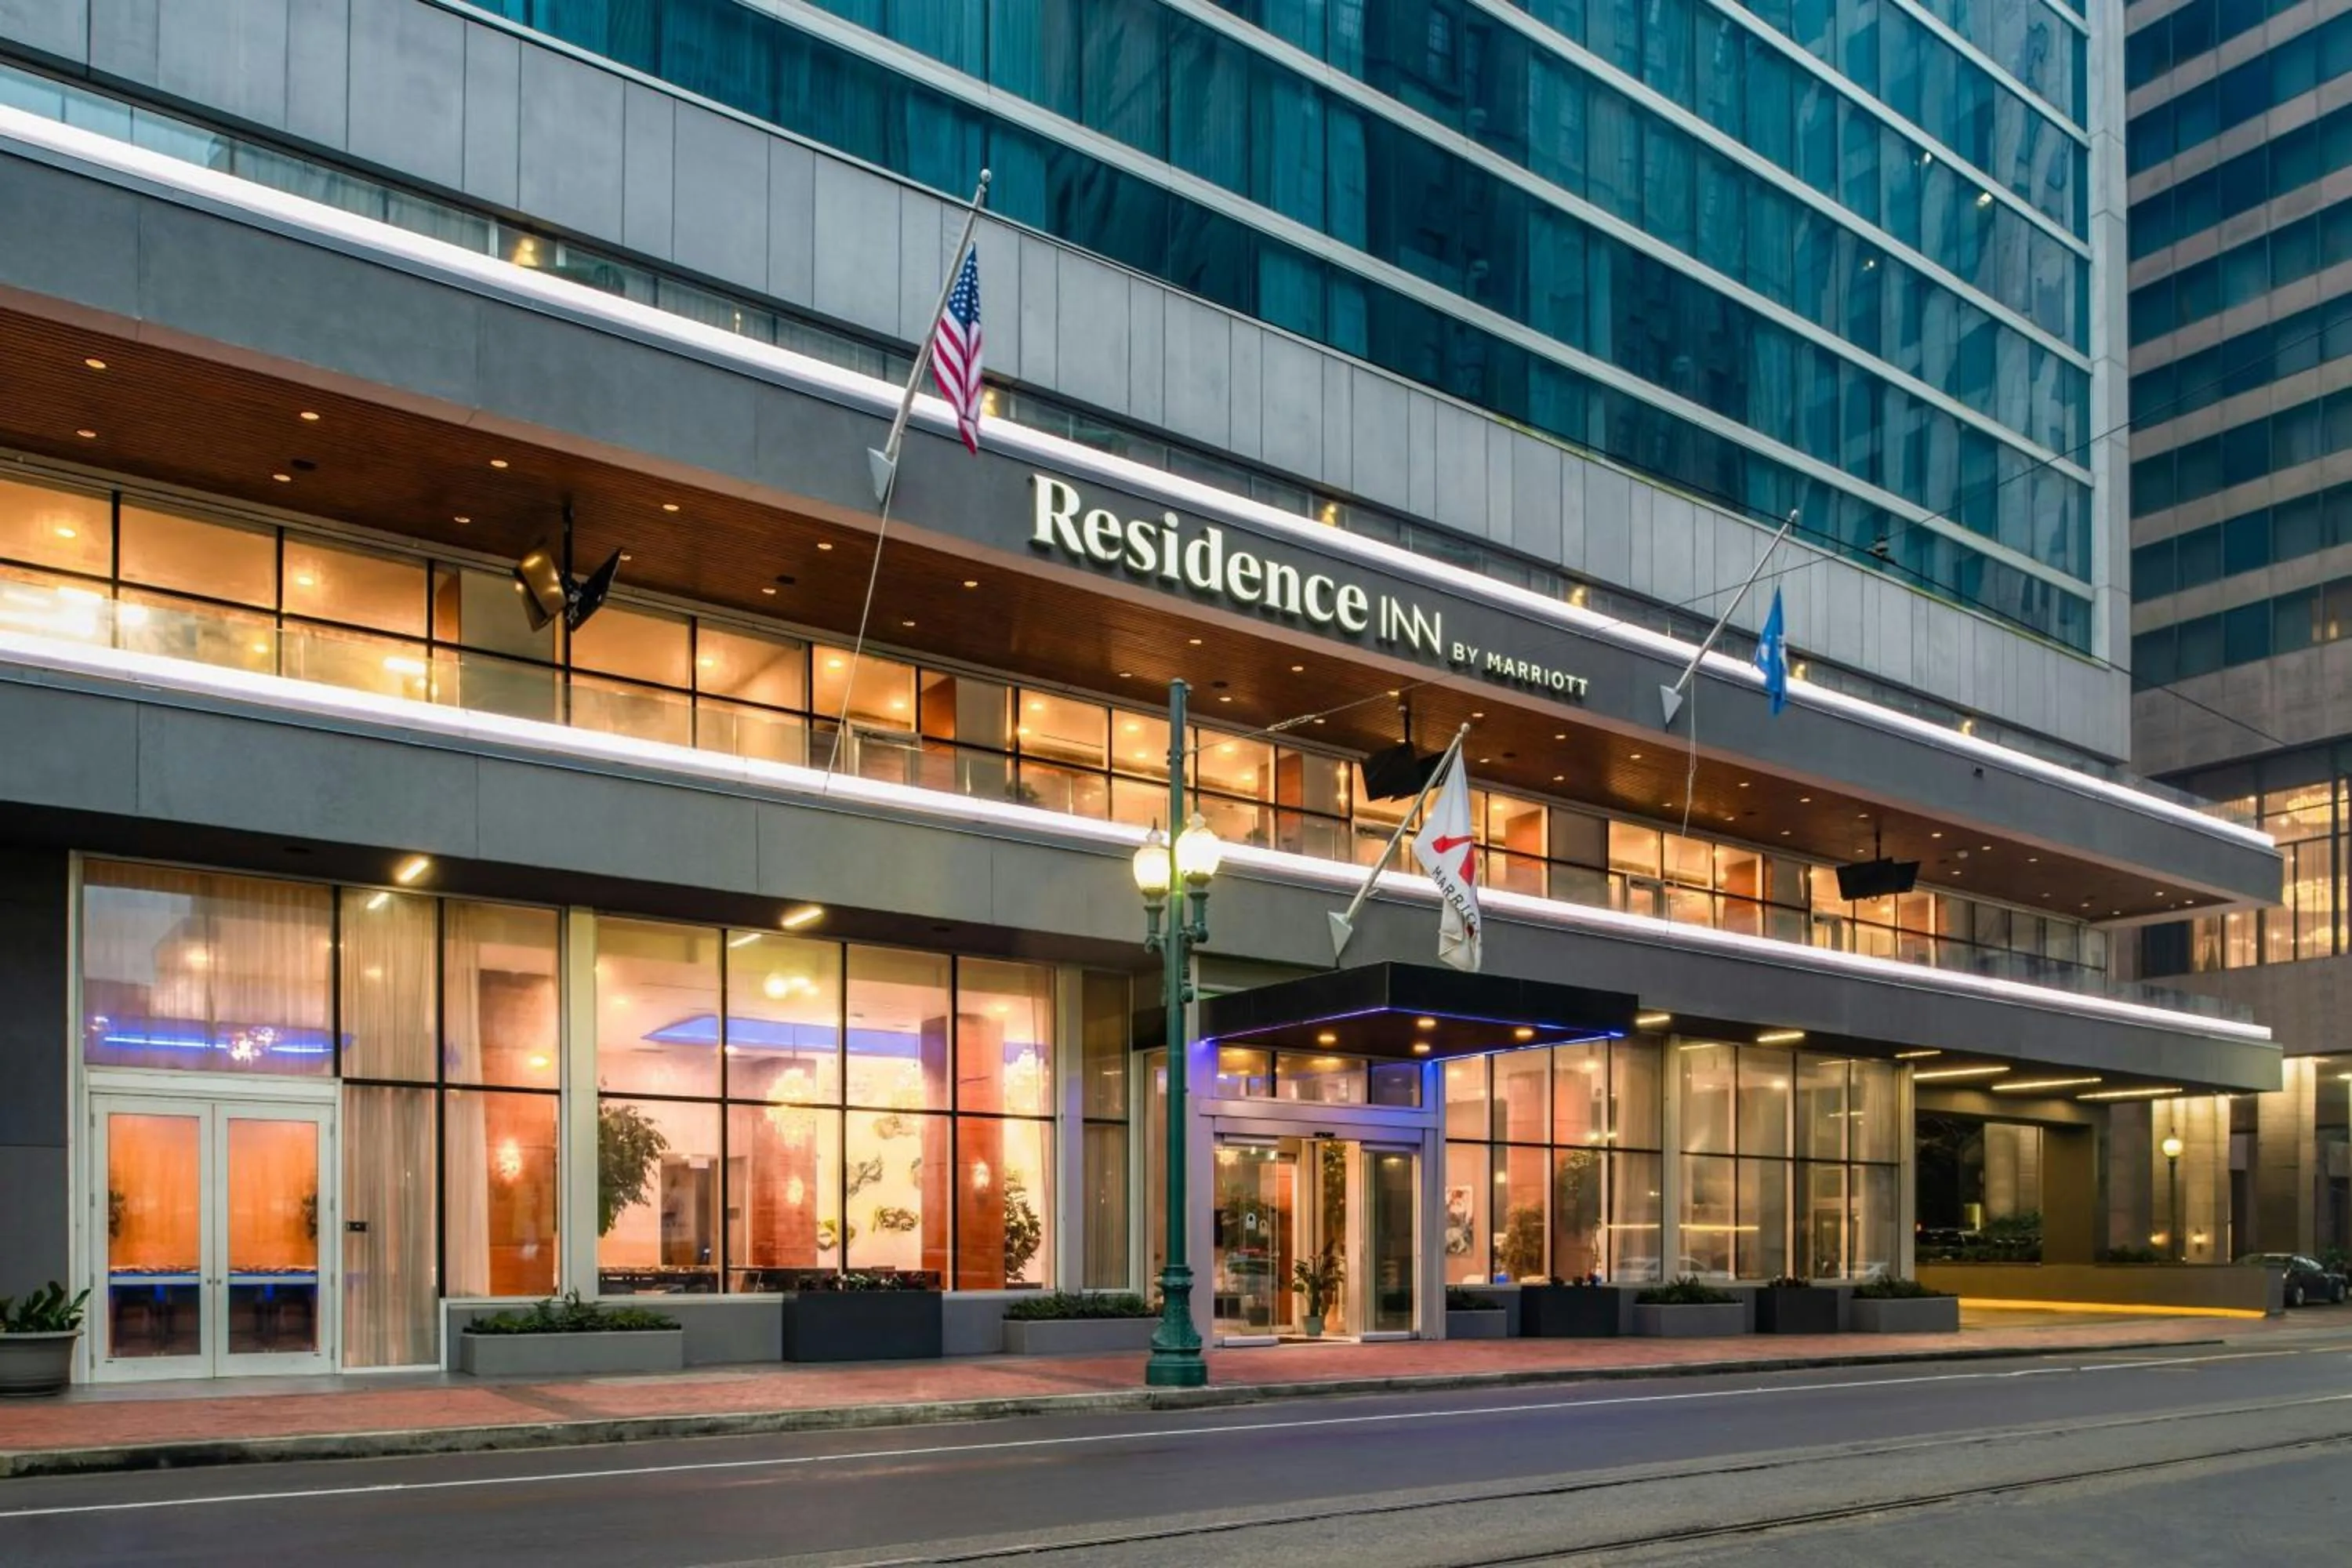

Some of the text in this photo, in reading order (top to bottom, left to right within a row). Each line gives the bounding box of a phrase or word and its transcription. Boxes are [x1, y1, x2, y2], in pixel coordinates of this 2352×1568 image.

[1031, 473, 1588, 696] Residence INN BY MARRIOTT
[1432, 865, 1477, 927] MARRIO
